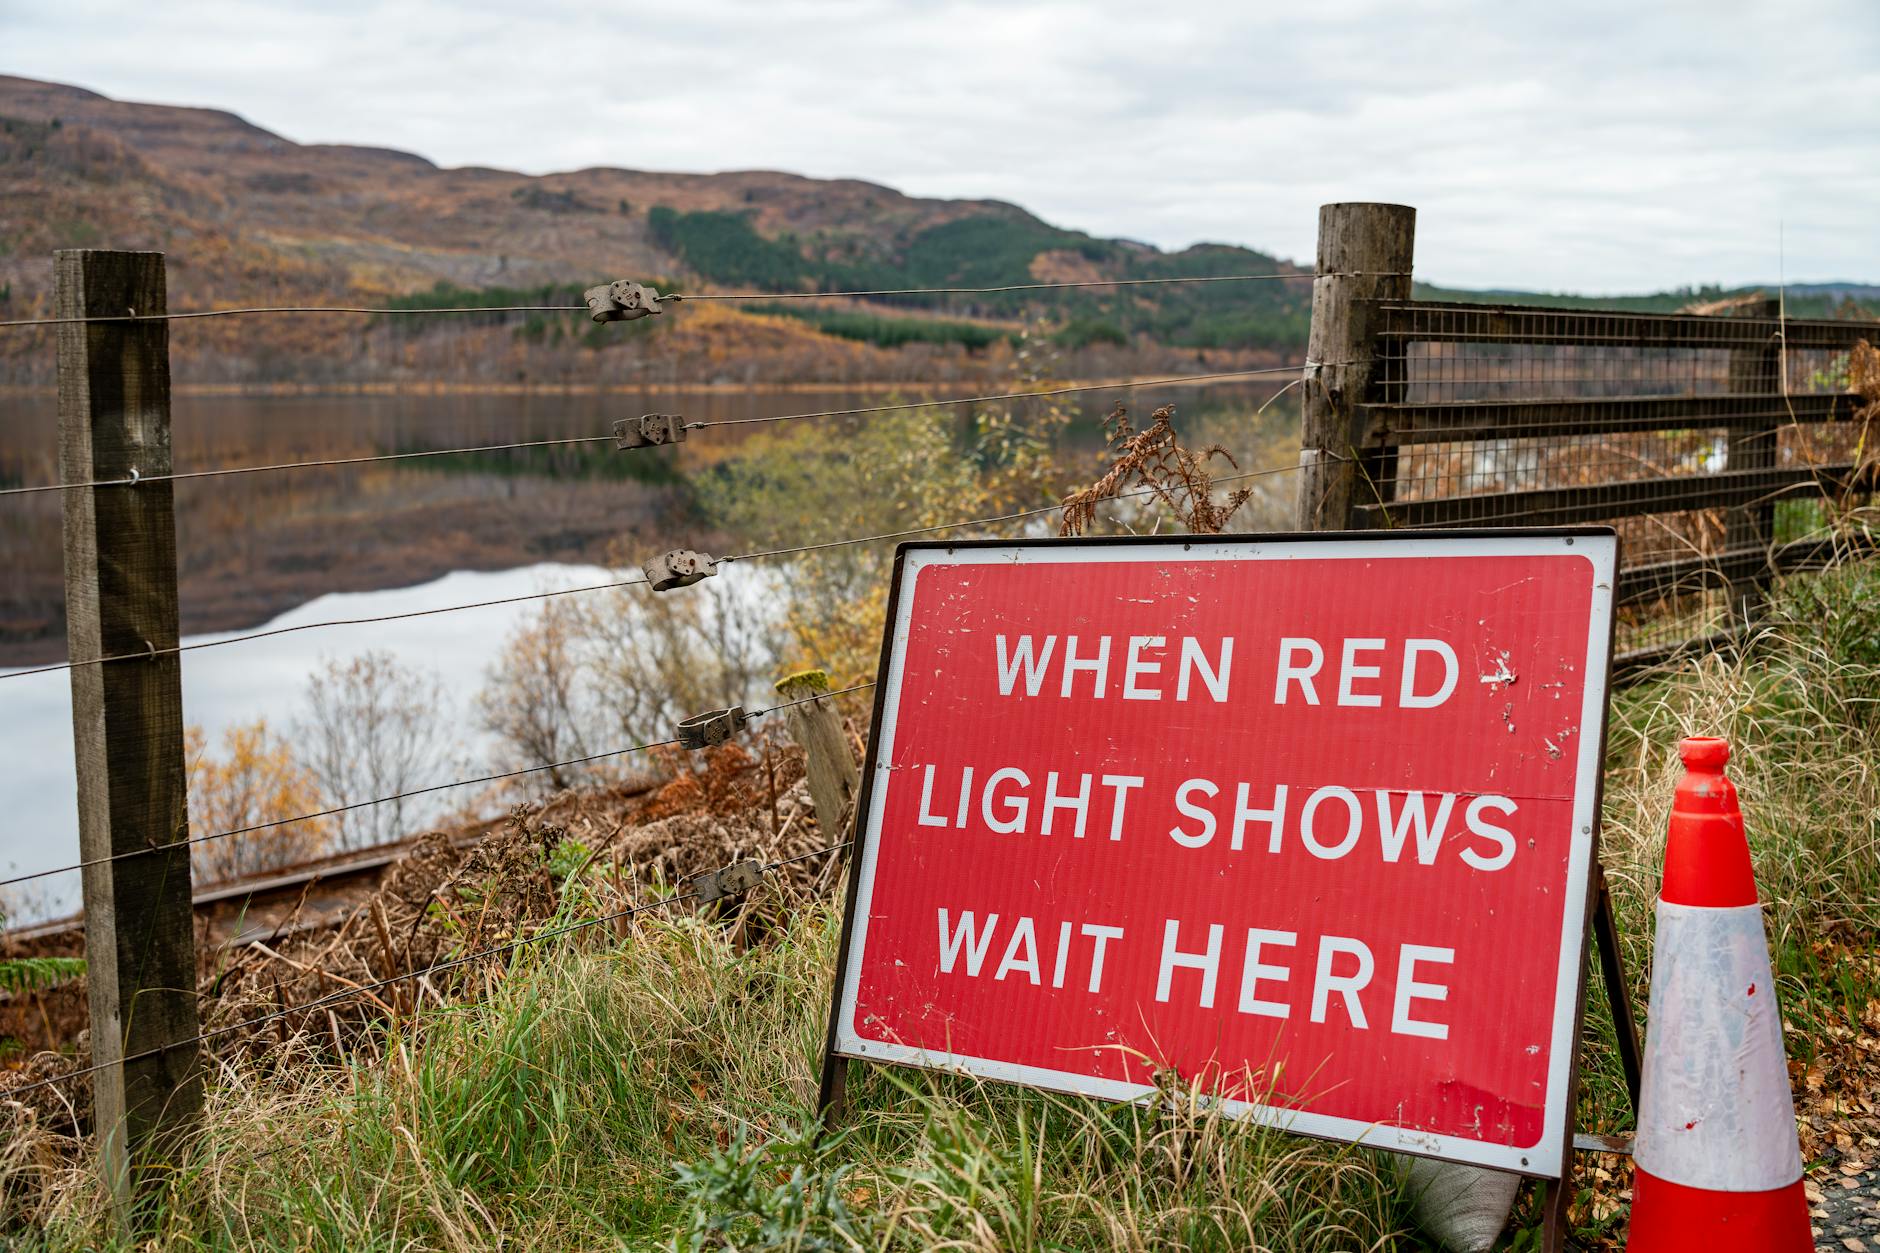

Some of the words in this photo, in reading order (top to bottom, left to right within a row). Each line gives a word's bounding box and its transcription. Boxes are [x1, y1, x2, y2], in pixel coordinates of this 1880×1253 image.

[995, 634, 1235, 703] WHEN
[1274, 637, 1460, 709] RED
[917, 764, 1145, 841] LIGHT
[1169, 778, 1519, 872] SHOWS
[937, 907, 1125, 994] WAIT
[1155, 919, 1456, 1040] HERE
